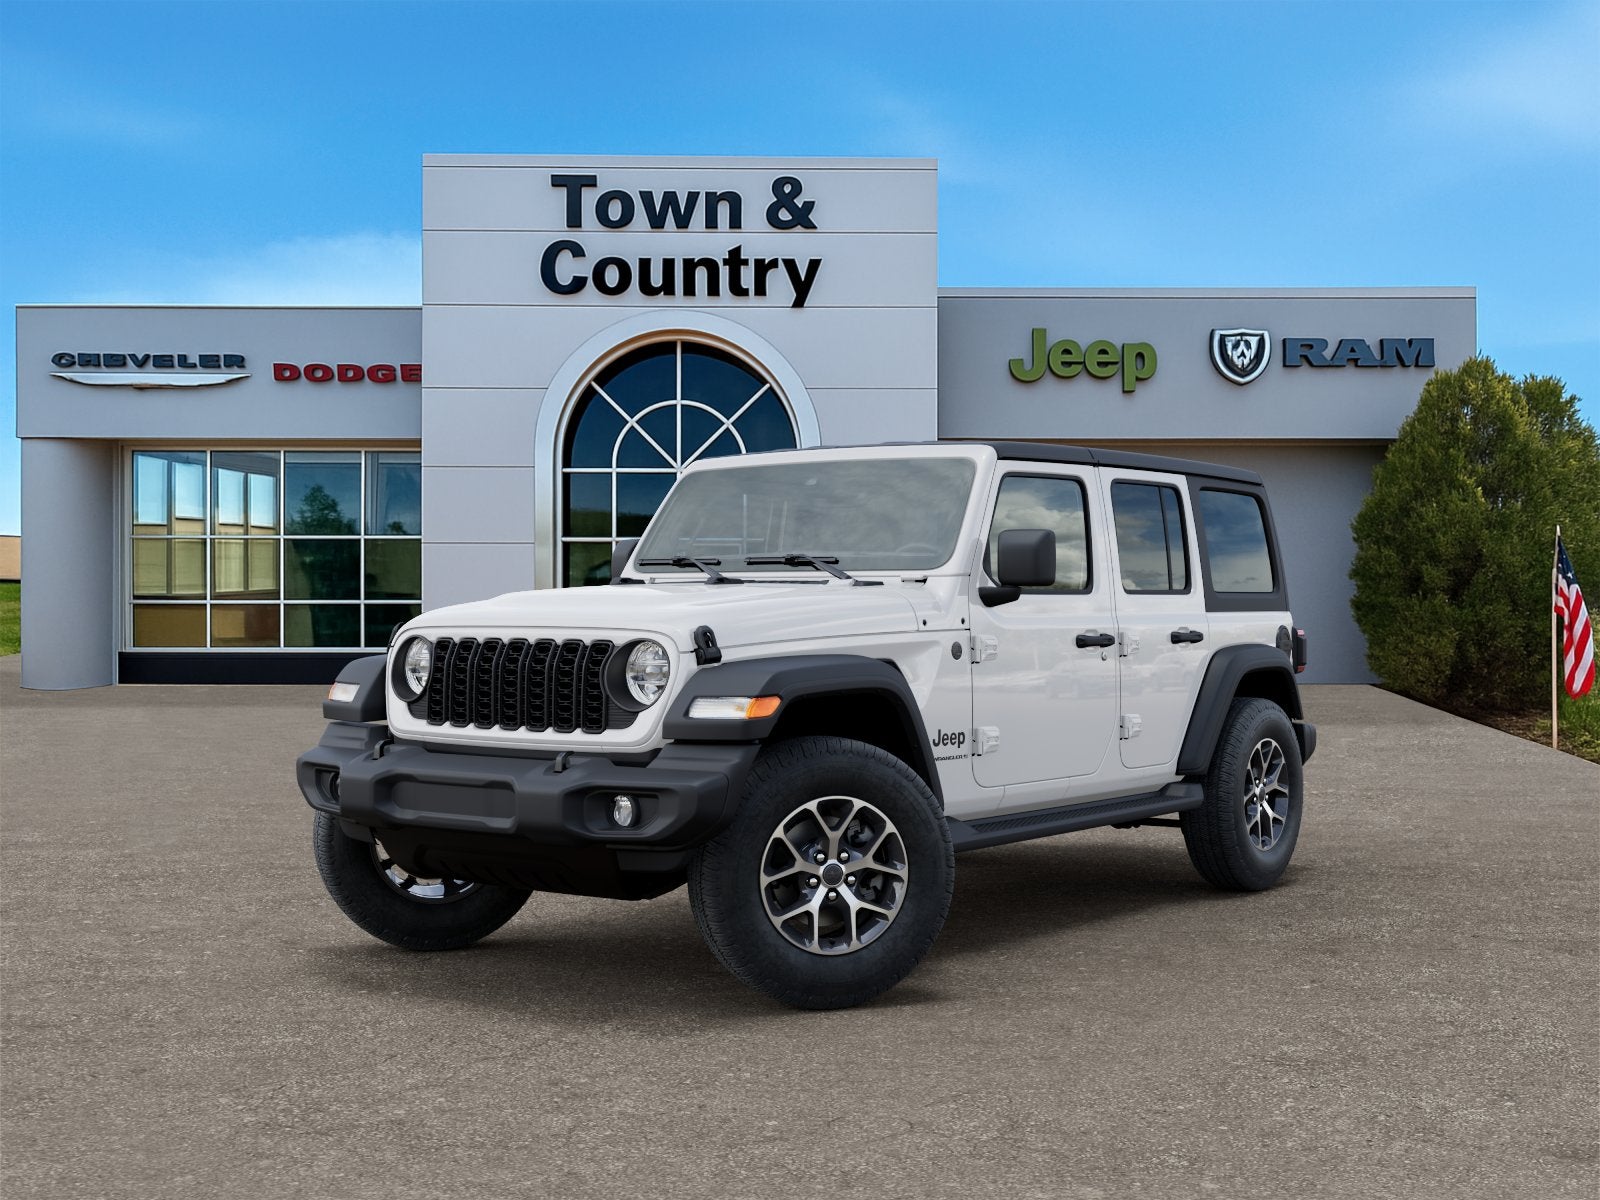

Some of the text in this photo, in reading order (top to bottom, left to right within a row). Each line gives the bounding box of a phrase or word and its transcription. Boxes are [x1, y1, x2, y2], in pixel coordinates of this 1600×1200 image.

[551, 174, 818, 230] Town &
[540, 239, 822, 308] Country
[273, 363, 422, 383] DODGE
[1009, 328, 1157, 393] Jeep
[1282, 337, 1435, 368] RAM
[932, 729, 966, 749] Jeep
